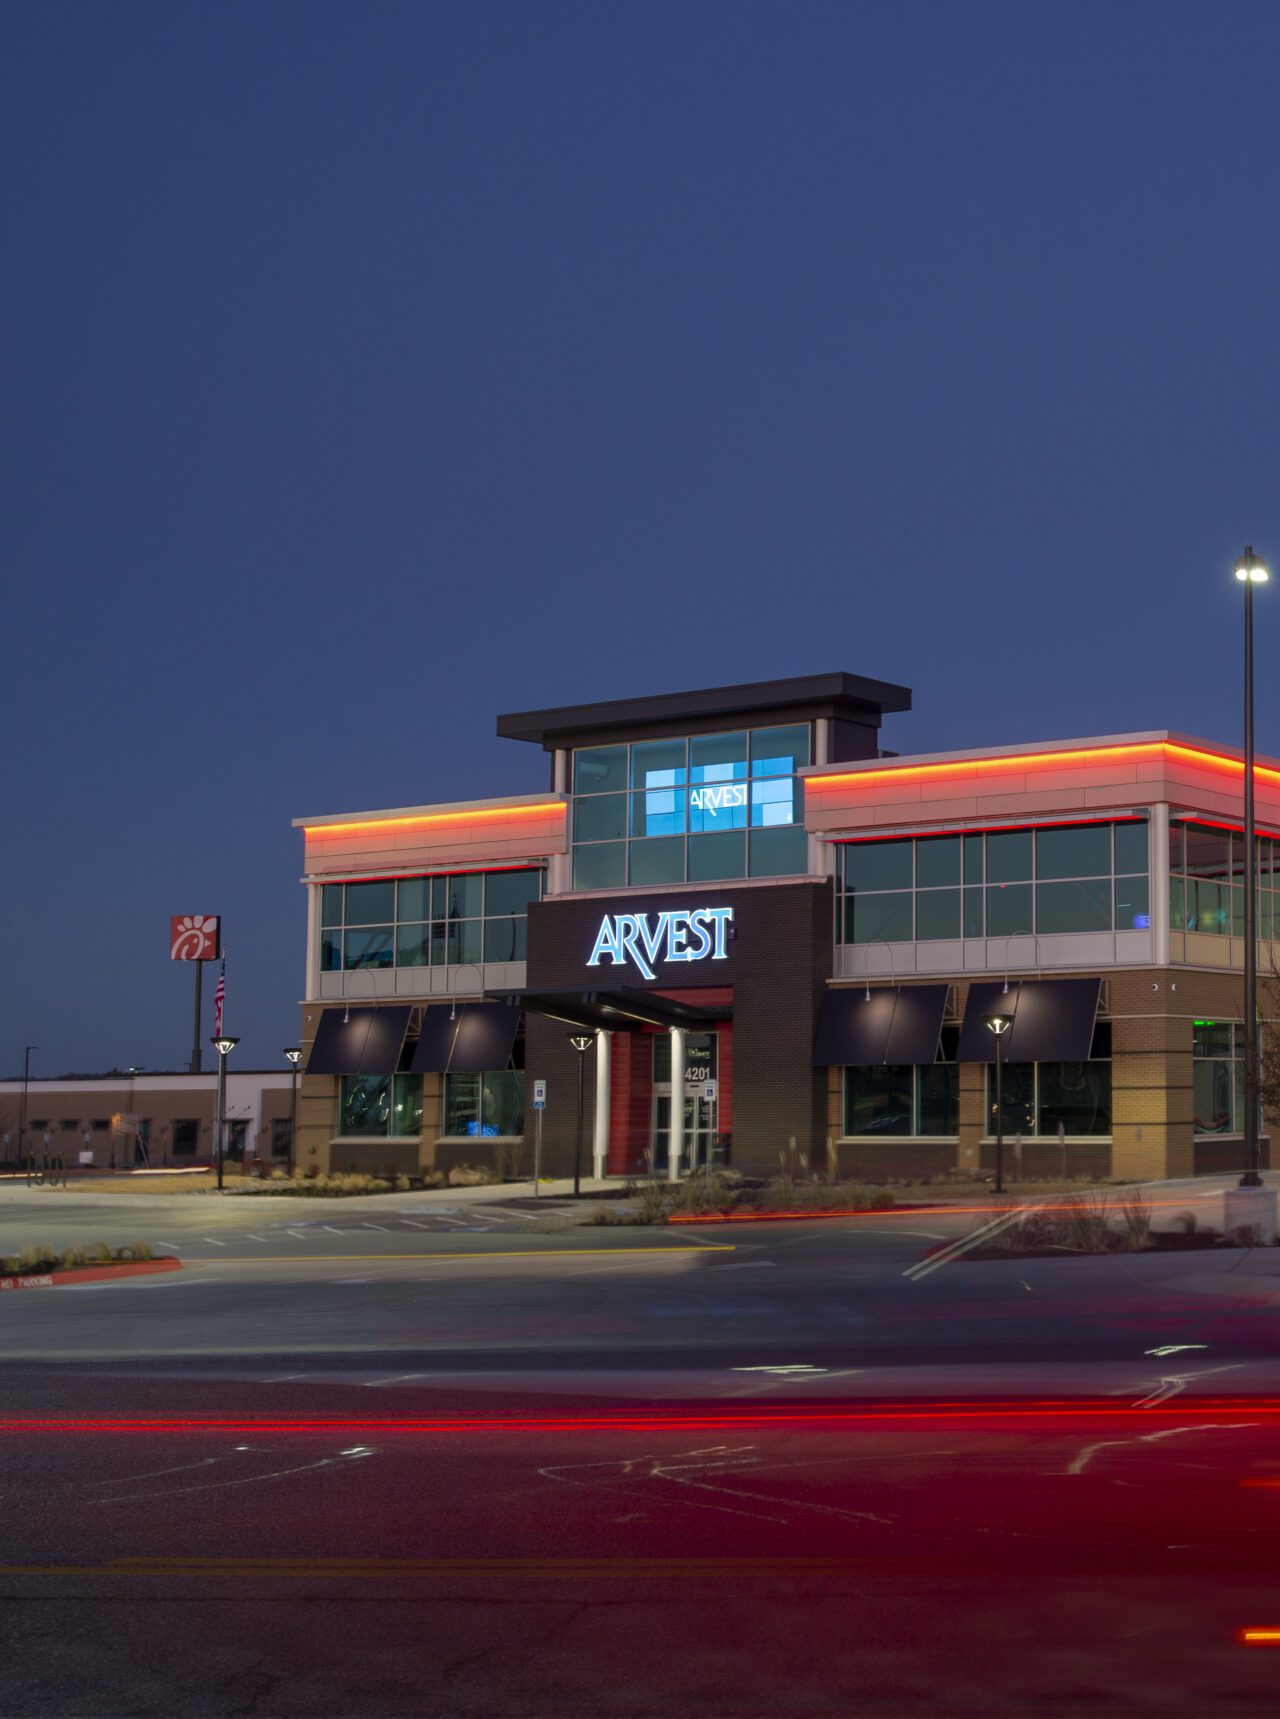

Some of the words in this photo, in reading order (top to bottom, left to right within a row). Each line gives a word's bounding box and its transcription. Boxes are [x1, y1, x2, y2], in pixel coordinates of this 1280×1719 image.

[690, 783, 748, 817] ARVEST
[585, 907, 734, 980] ARVEST
[685, 1066, 711, 1080] 4201
[0, 1278, 14, 1289] NO
